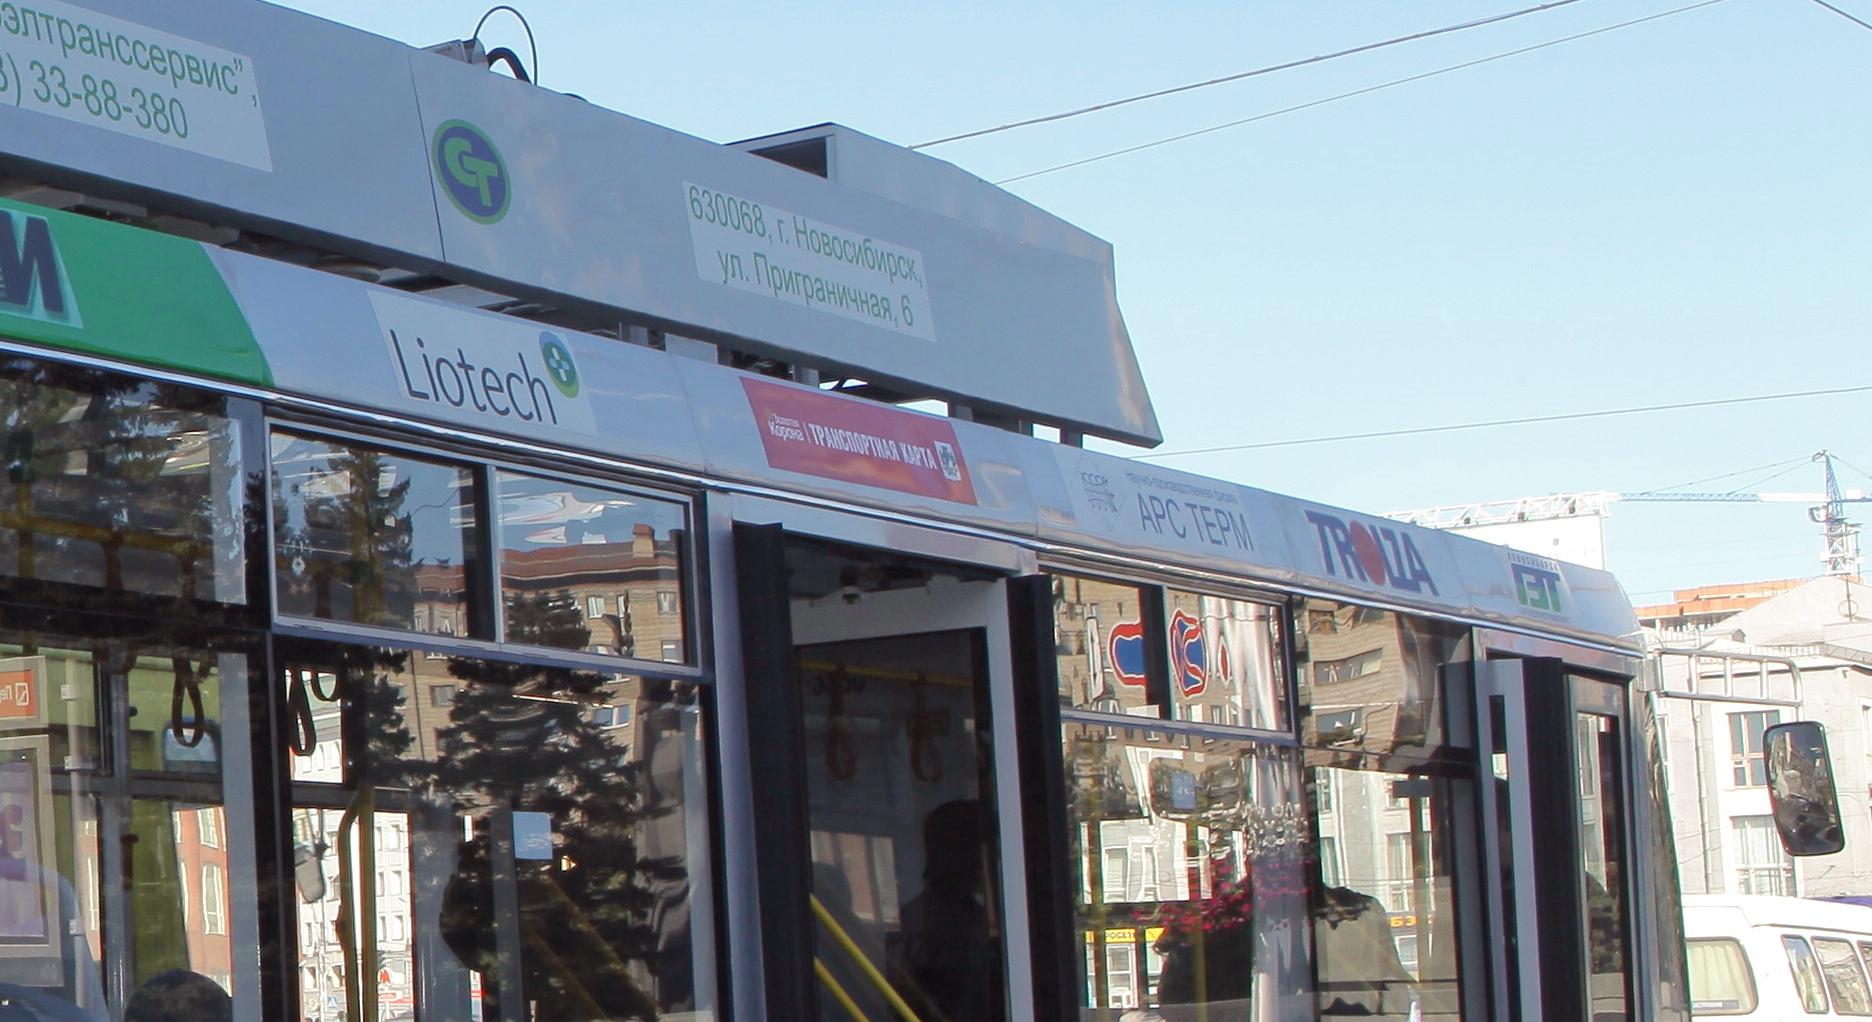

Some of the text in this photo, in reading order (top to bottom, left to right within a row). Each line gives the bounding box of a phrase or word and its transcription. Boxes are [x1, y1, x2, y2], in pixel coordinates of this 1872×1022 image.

[29, 59, 188, 139] 33-88-380
[689, 185, 923, 288] 630068, г. Новосибирск,
[717, 250, 914, 328] ул. Приграничная, 6
[389, 328, 557, 425] Liotech
[808, 423, 938, 471] ТРАНСПОРТНАЯ КАРТА
[1137, 492, 1255, 552] АРС ТЕРМ
